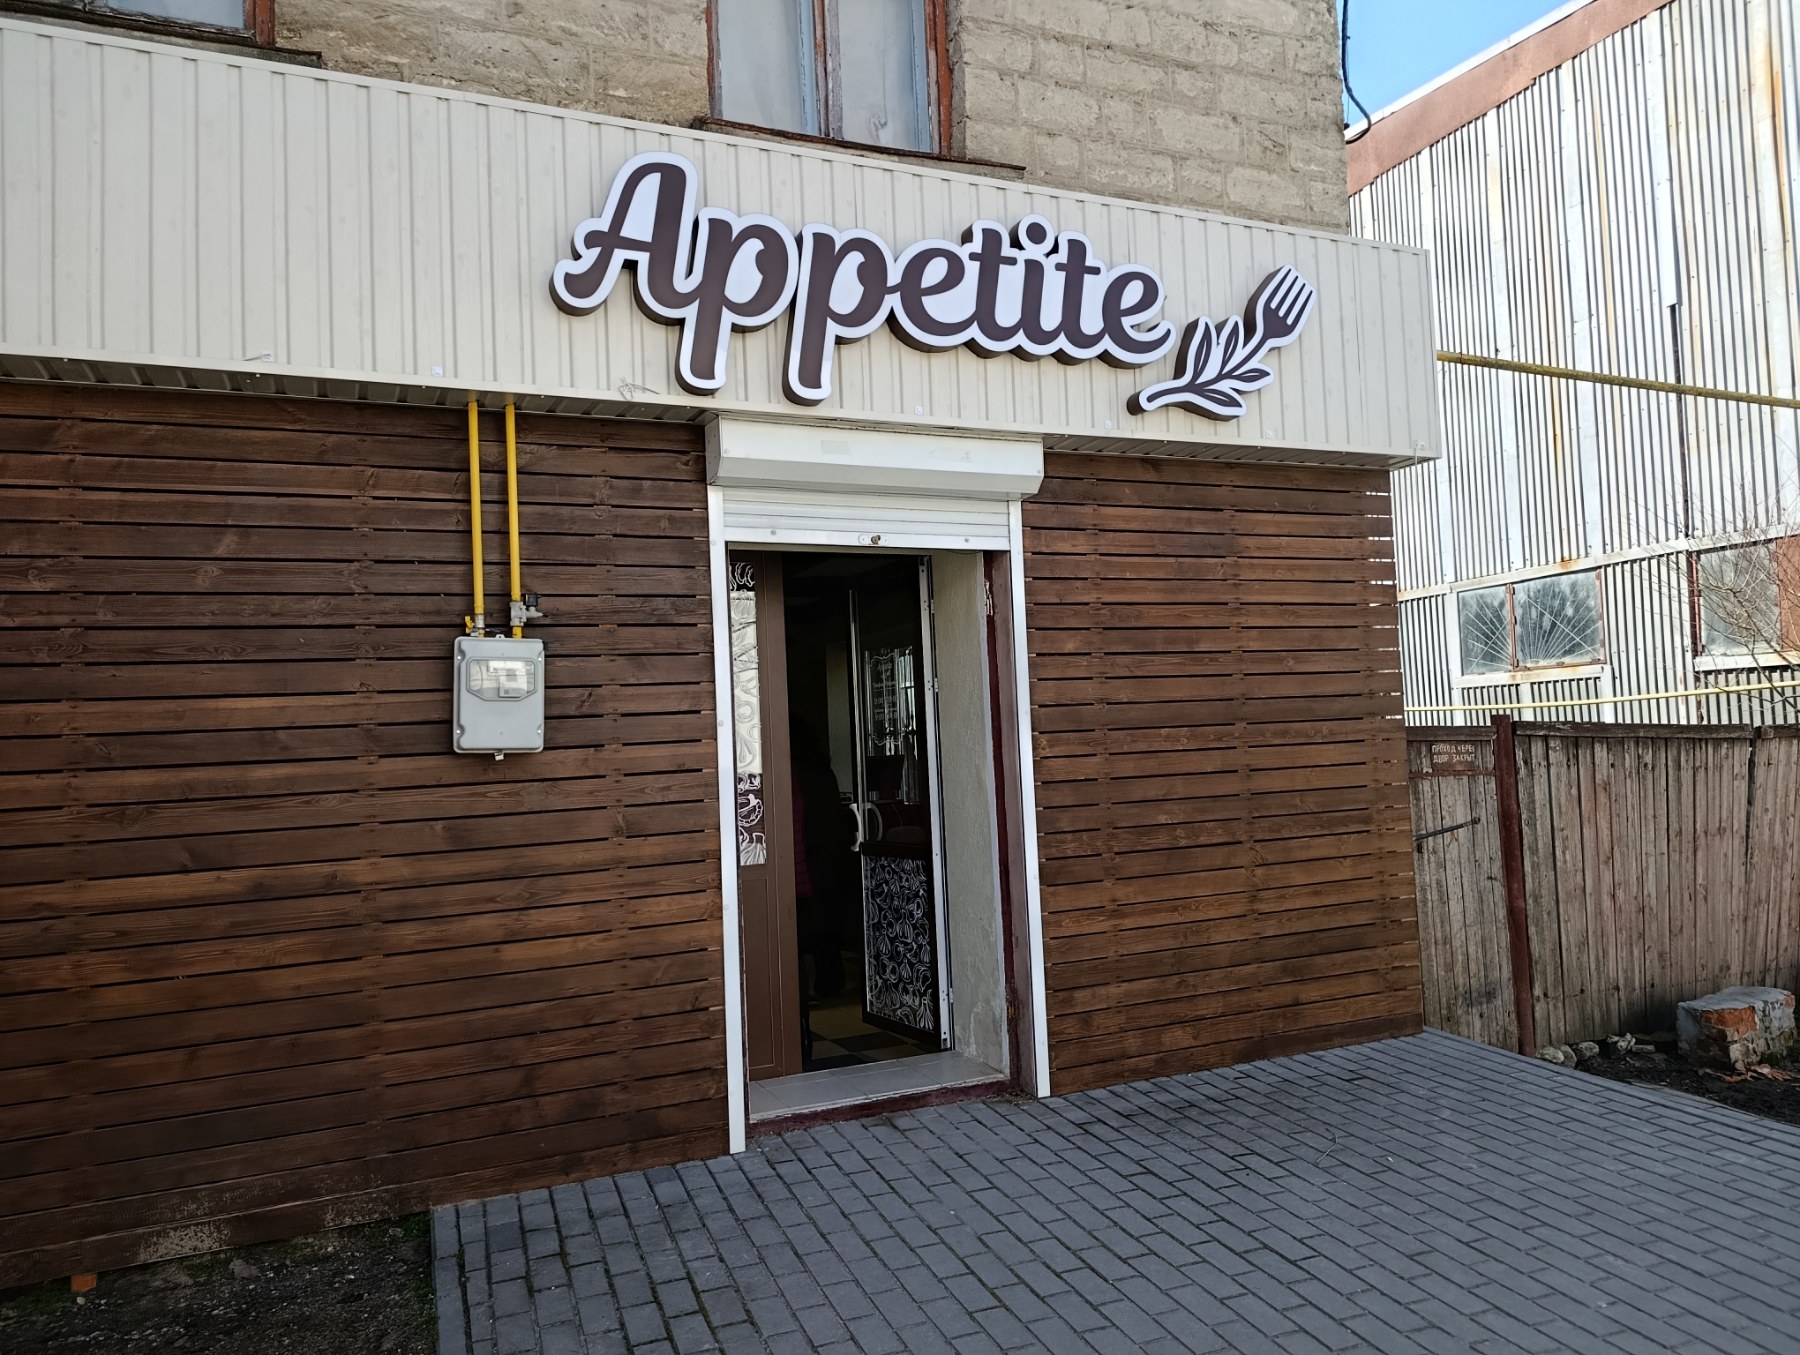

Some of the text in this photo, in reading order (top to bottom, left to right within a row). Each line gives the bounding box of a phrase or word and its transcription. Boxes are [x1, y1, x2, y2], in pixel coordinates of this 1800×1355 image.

[556, 156, 1173, 396] Appetite
[1433, 754, 1476, 763] ДВОР ЗАКРЫТ
